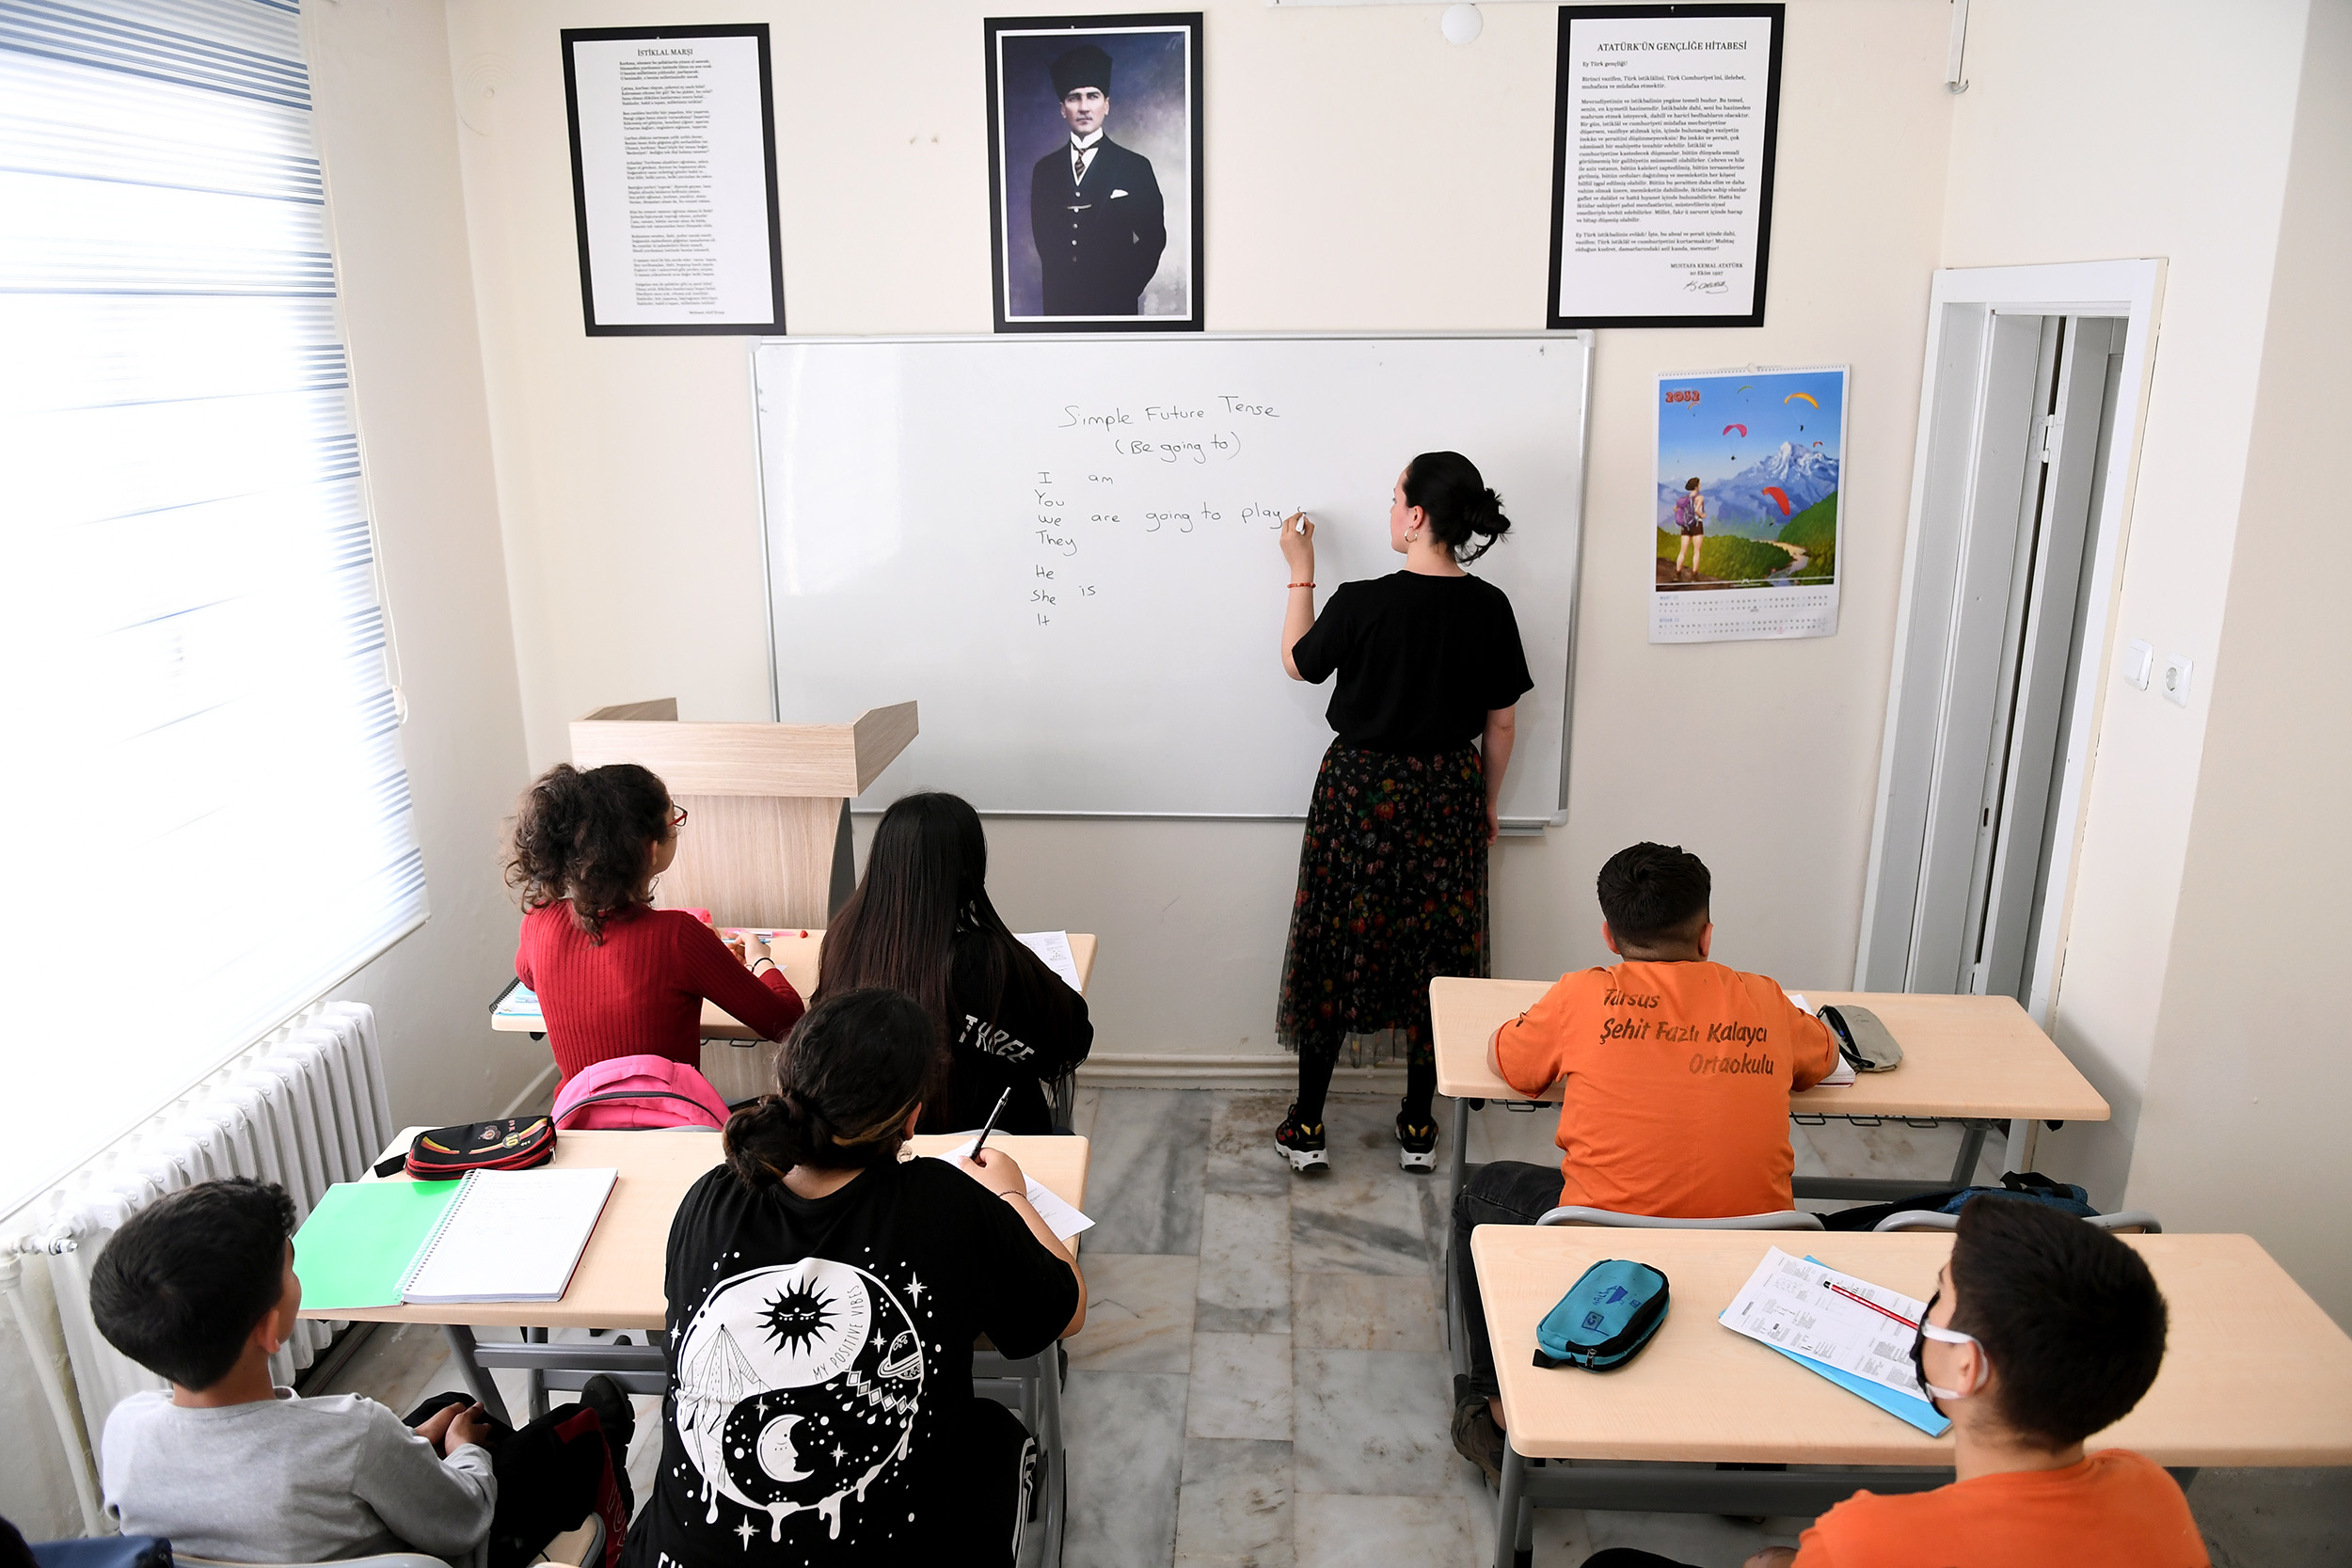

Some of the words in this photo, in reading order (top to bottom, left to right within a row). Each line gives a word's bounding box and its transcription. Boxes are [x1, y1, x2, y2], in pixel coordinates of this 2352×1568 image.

[671, 48, 693, 56] MARŞI
[1597, 41, 1655, 51] ATATÜRK'ÜN
[1656, 40, 1703, 53] GENÇLİĞE
[1705, 40, 1747, 51] HİTABESİ
[1058, 405, 1133, 432] Simple
[1145, 405, 1203, 420] Future
[1218, 396, 1279, 417] Tense
[1116, 439, 1153, 454] (Be
[1160, 443, 1205, 464] going
[1211, 432, 1240, 459] to)
[1038, 472, 1052, 483] I
[1089, 475, 1113, 483] am
[1035, 489, 1064, 507] You
[1146, 513, 1193, 532] going
[1201, 502, 1221, 520] to
[1242, 501, 1283, 530] play
[1036, 530, 1077, 556] They
[1036, 564, 1054, 579] He
[1030, 590, 1056, 605] She
[1079, 586, 1095, 596] is
[1038, 613, 1050, 626] It
[1603, 988, 1661, 1009] Tarsus
[959, 1014, 1035, 1064] THREE
[1599, 1017, 1651, 1045] Şehit
[1655, 1022, 1700, 1043] Fazlı
[1707, 1022, 1768, 1048] Kalaycı
[1689, 1053, 1774, 1076] Ortaokulu
[812, 1362, 829, 1381] MY
[829, 1323, 864, 1370] POSITIVE
[847, 1285, 865, 1317] VIBES
